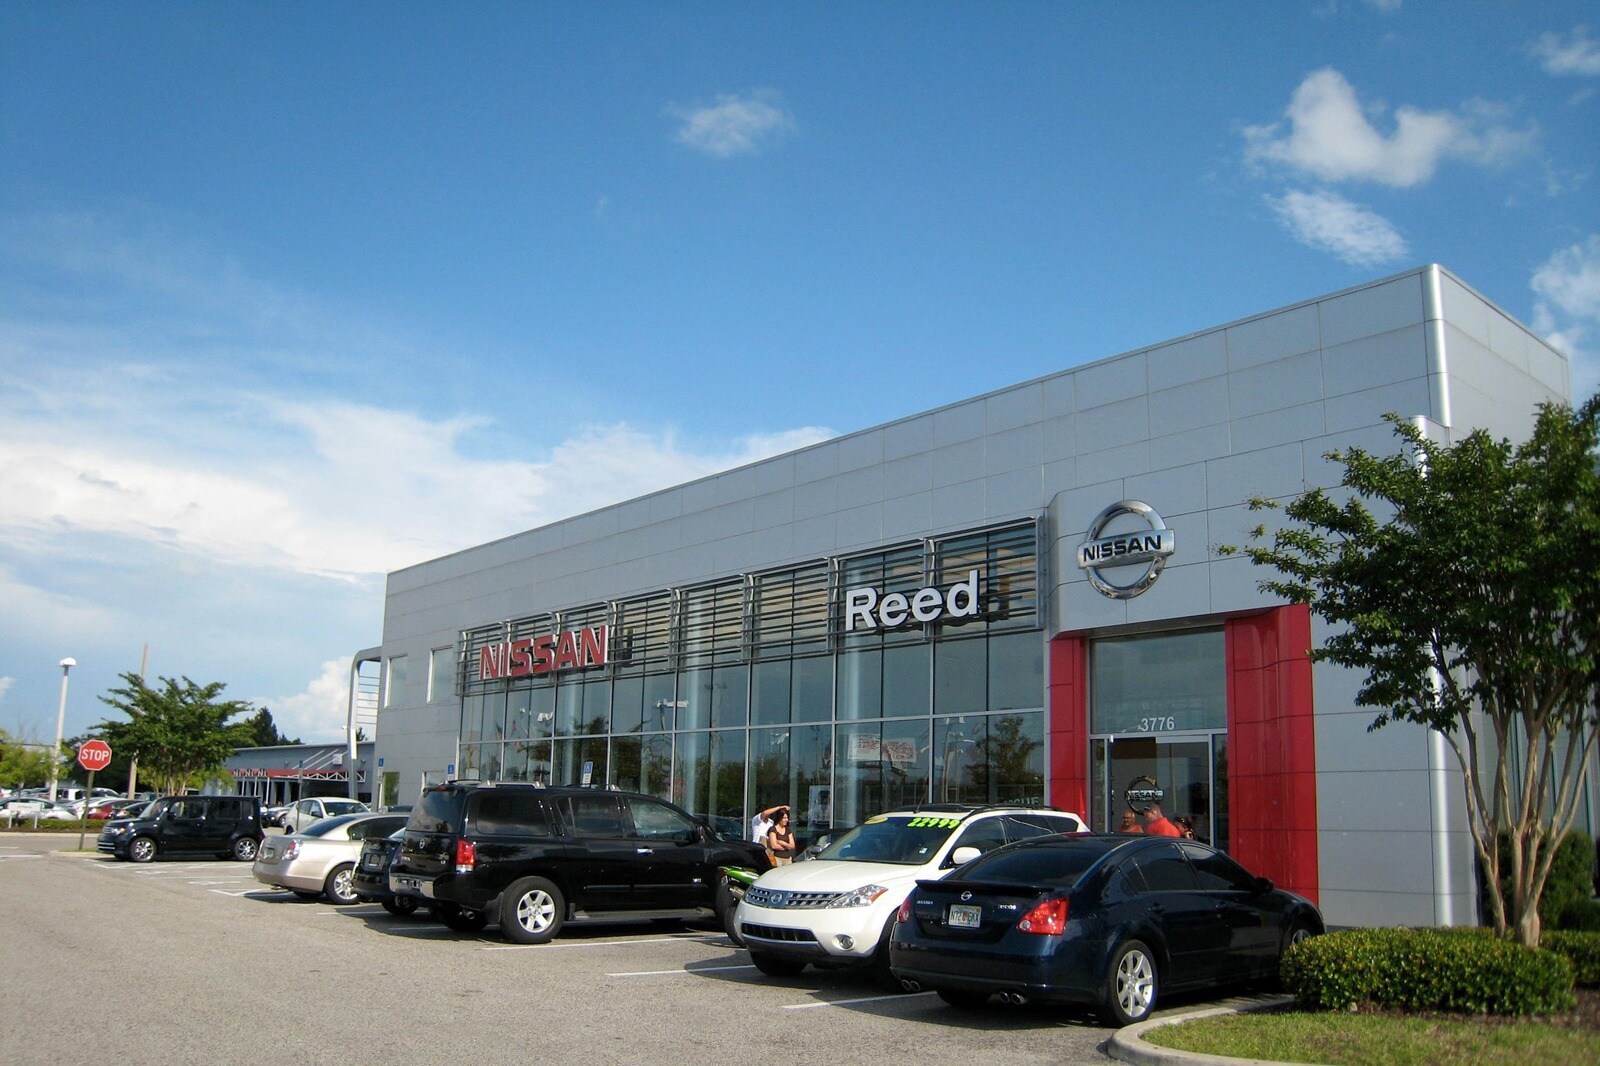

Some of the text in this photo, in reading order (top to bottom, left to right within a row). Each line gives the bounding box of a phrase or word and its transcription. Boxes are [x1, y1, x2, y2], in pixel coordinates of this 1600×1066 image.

[1083, 534, 1161, 562] NISSAN
[845, 569, 980, 631] Reed
[479, 624, 609, 680] NISSAN
[1141, 716, 1175, 732] 3776
[81, 748, 110, 762] STOP
[907, 817, 961, 829] 22999
